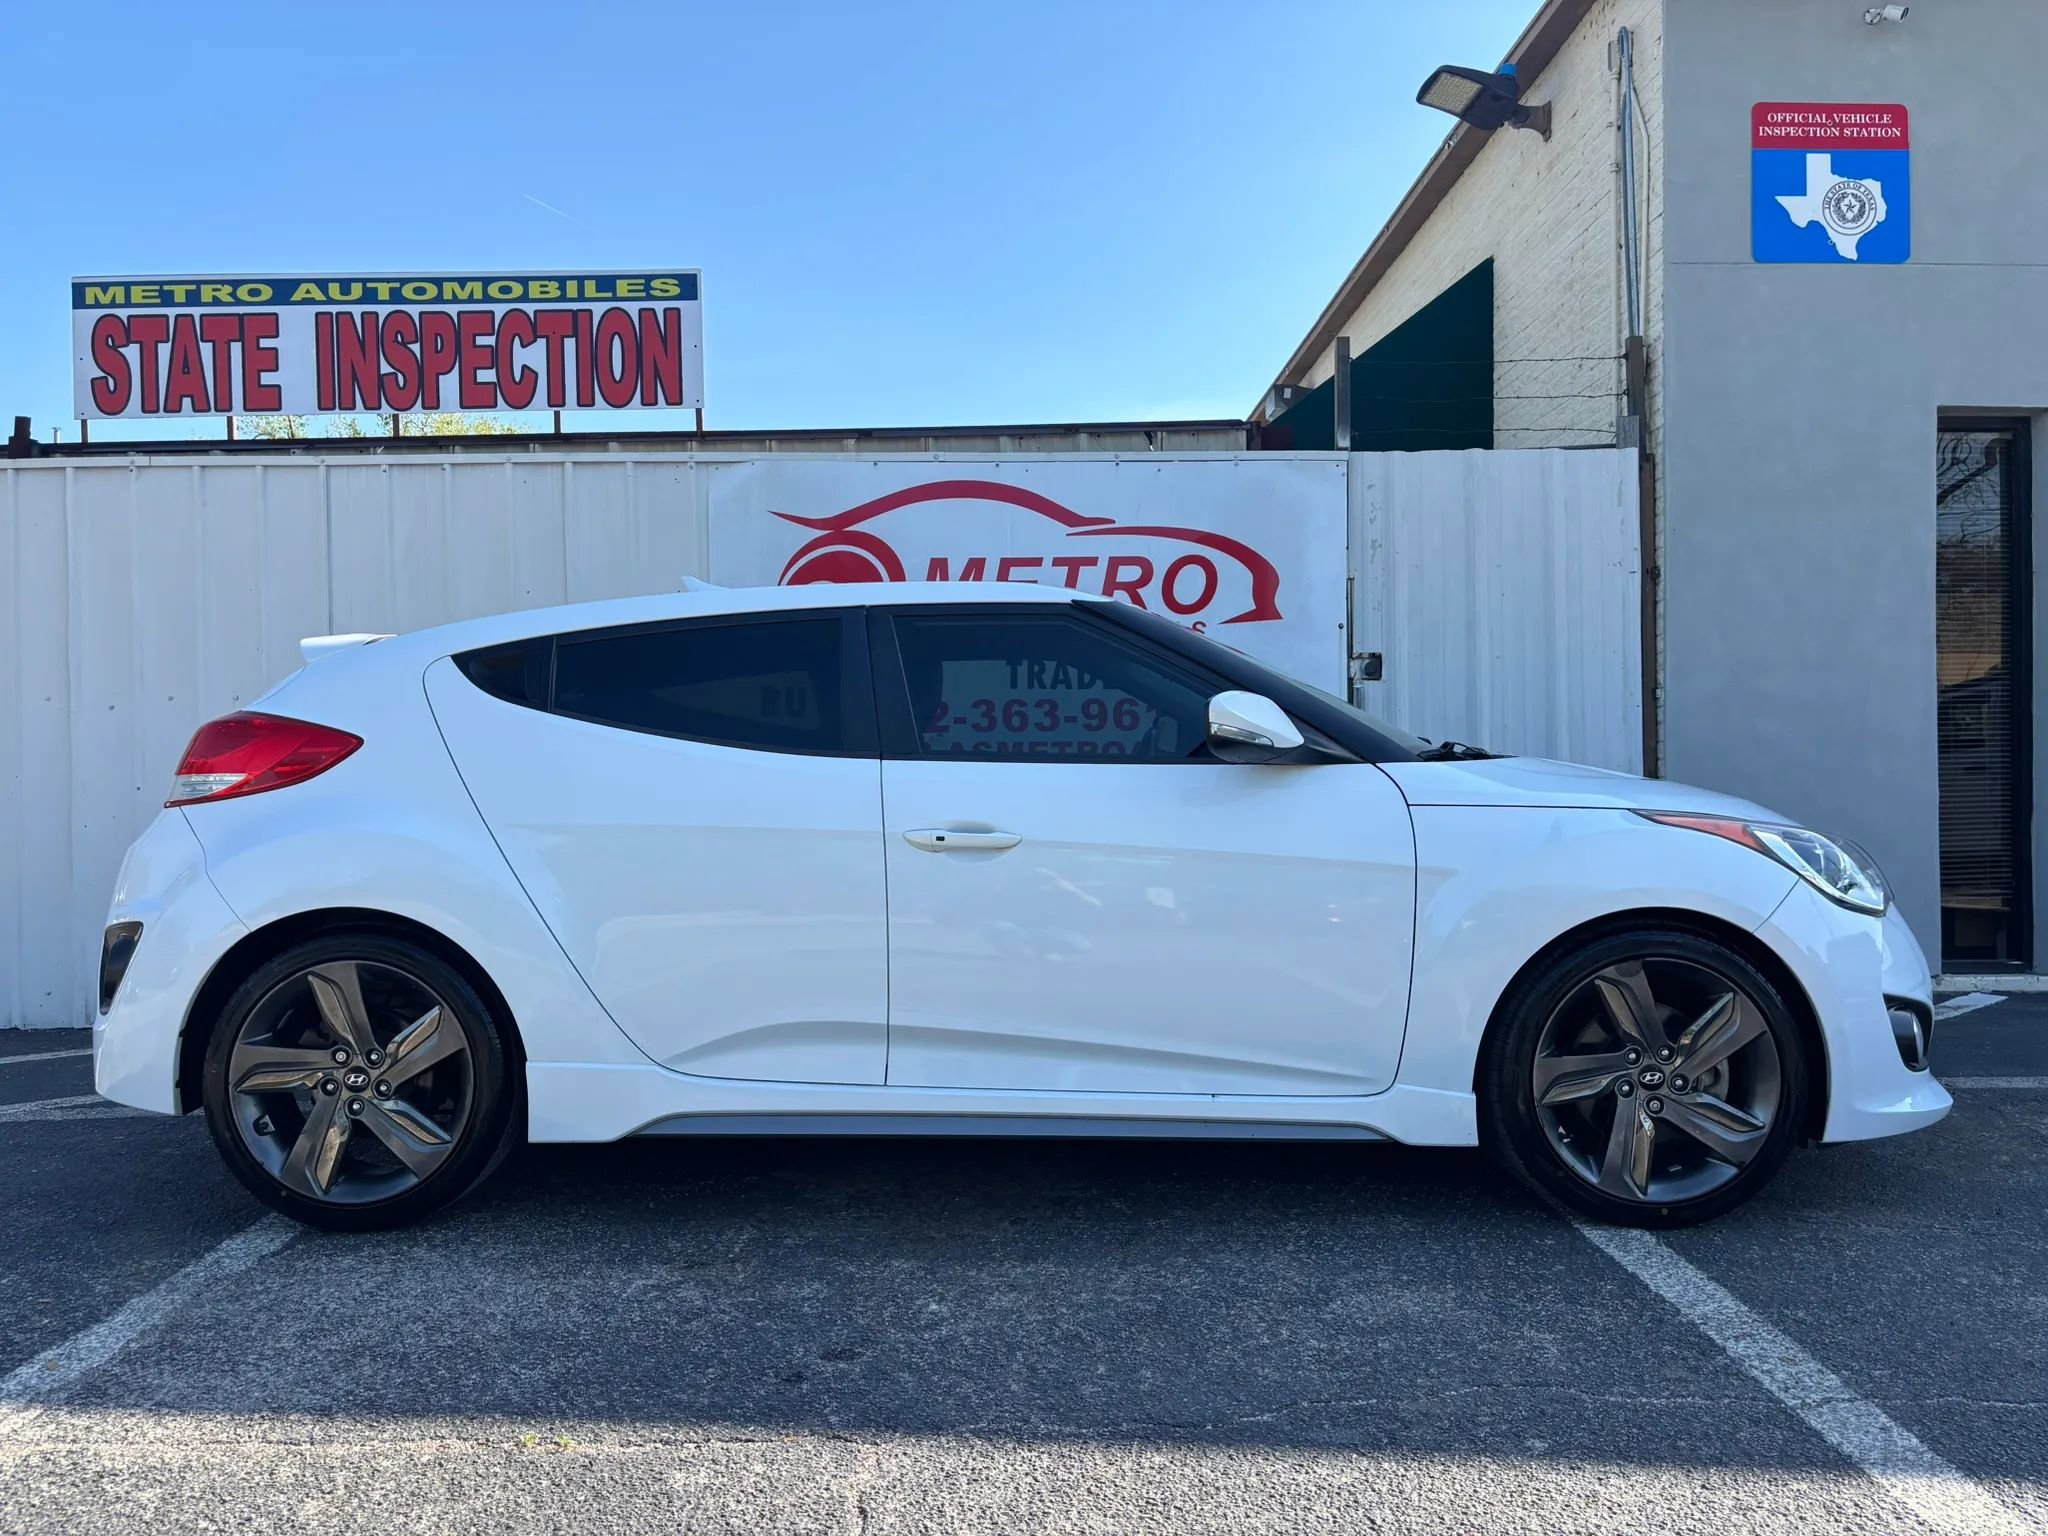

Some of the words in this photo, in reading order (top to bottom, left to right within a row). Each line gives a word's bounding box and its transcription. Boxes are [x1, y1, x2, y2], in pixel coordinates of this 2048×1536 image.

[1767, 113, 1828, 124] OFFICIAL
[1833, 113, 1892, 124] VEHICLE
[1759, 126, 1839, 137] INSPECTION
[1843, 127, 1901, 138] STATION
[84, 283, 273, 305] METRO
[290, 278, 682, 302] AUTOMOBILES
[91, 313, 282, 415] STATE
[314, 306, 685, 411] INSPECTION
